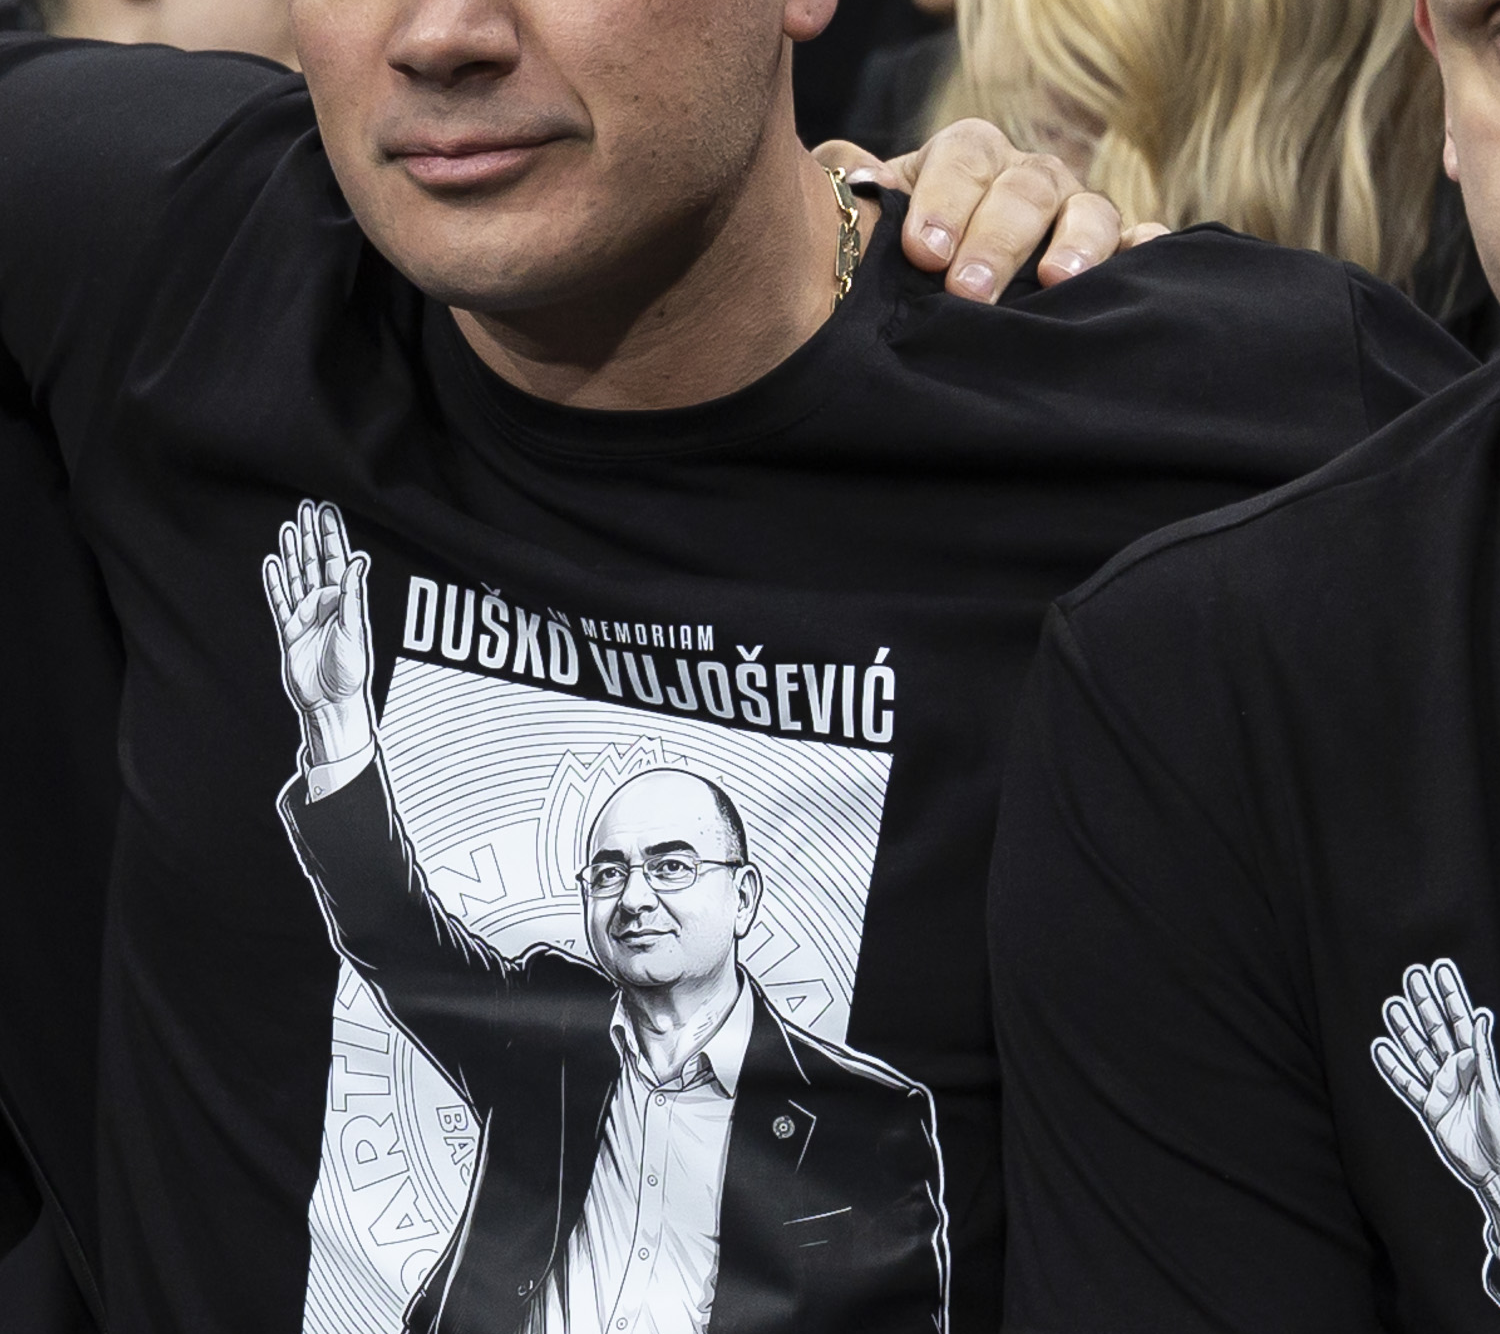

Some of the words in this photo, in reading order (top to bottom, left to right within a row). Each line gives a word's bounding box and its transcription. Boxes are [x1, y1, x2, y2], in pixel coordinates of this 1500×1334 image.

[403, 575, 579, 685] DUŠKO
[589, 641, 896, 743] VUJOŠEVIĆ
[580, 617, 714, 652] MEMORIAM
